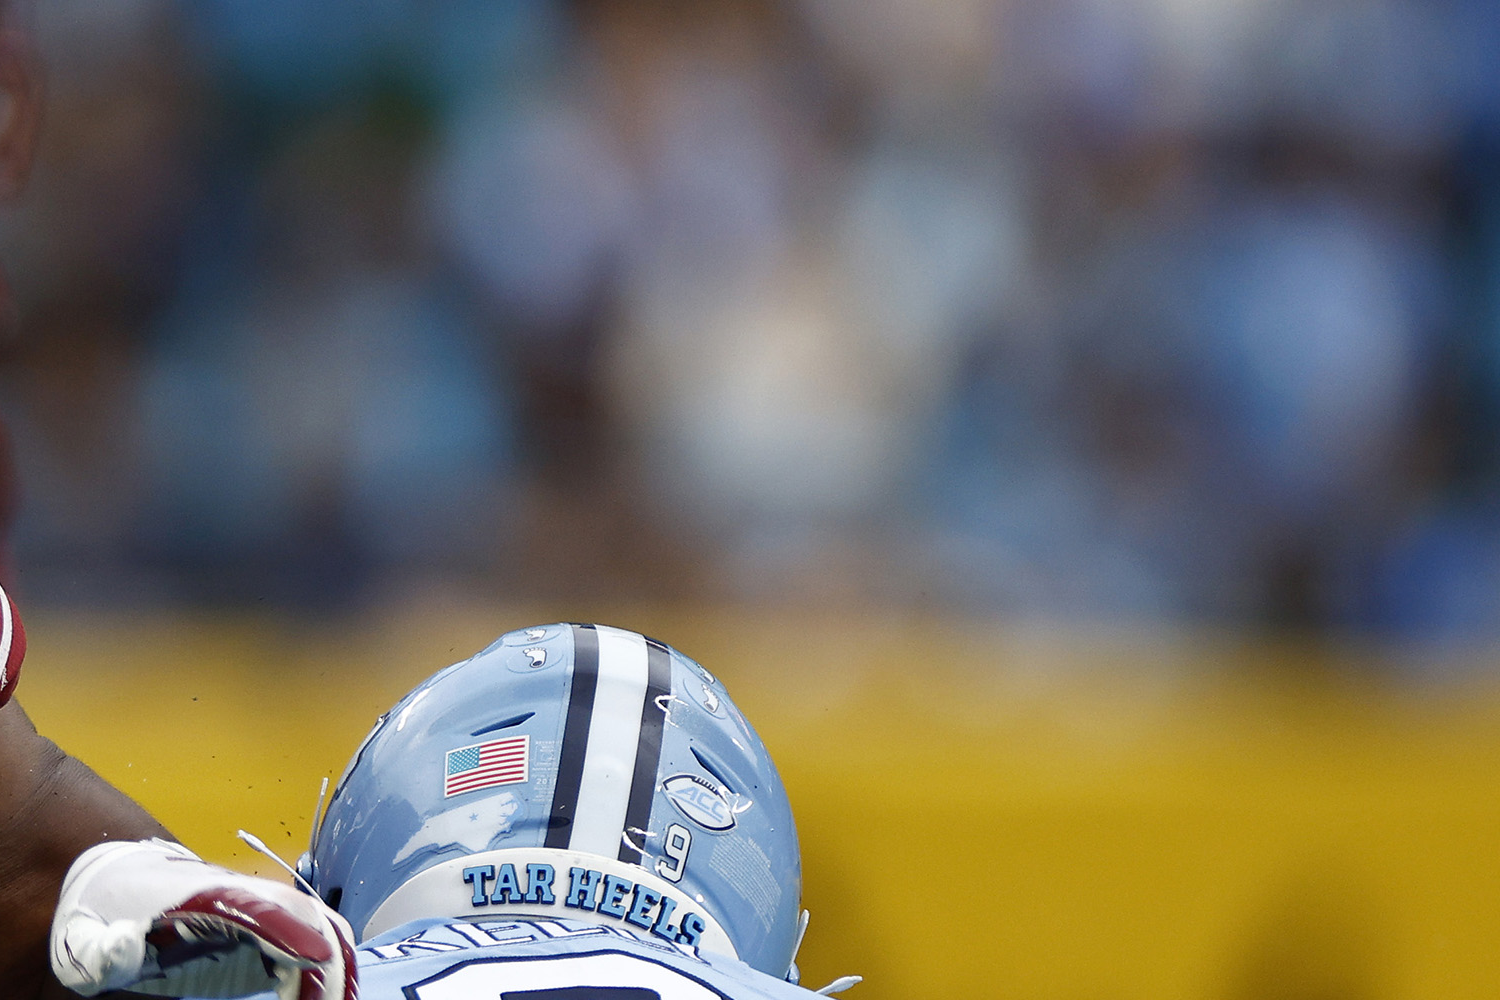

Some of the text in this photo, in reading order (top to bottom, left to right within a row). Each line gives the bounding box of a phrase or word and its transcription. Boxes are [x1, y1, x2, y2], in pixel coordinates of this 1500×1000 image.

[675, 786, 726, 820] ACC
[658, 823, 692, 883] 9
[463, 863, 556, 907] TAR
[565, 867, 706, 946] HEELS
